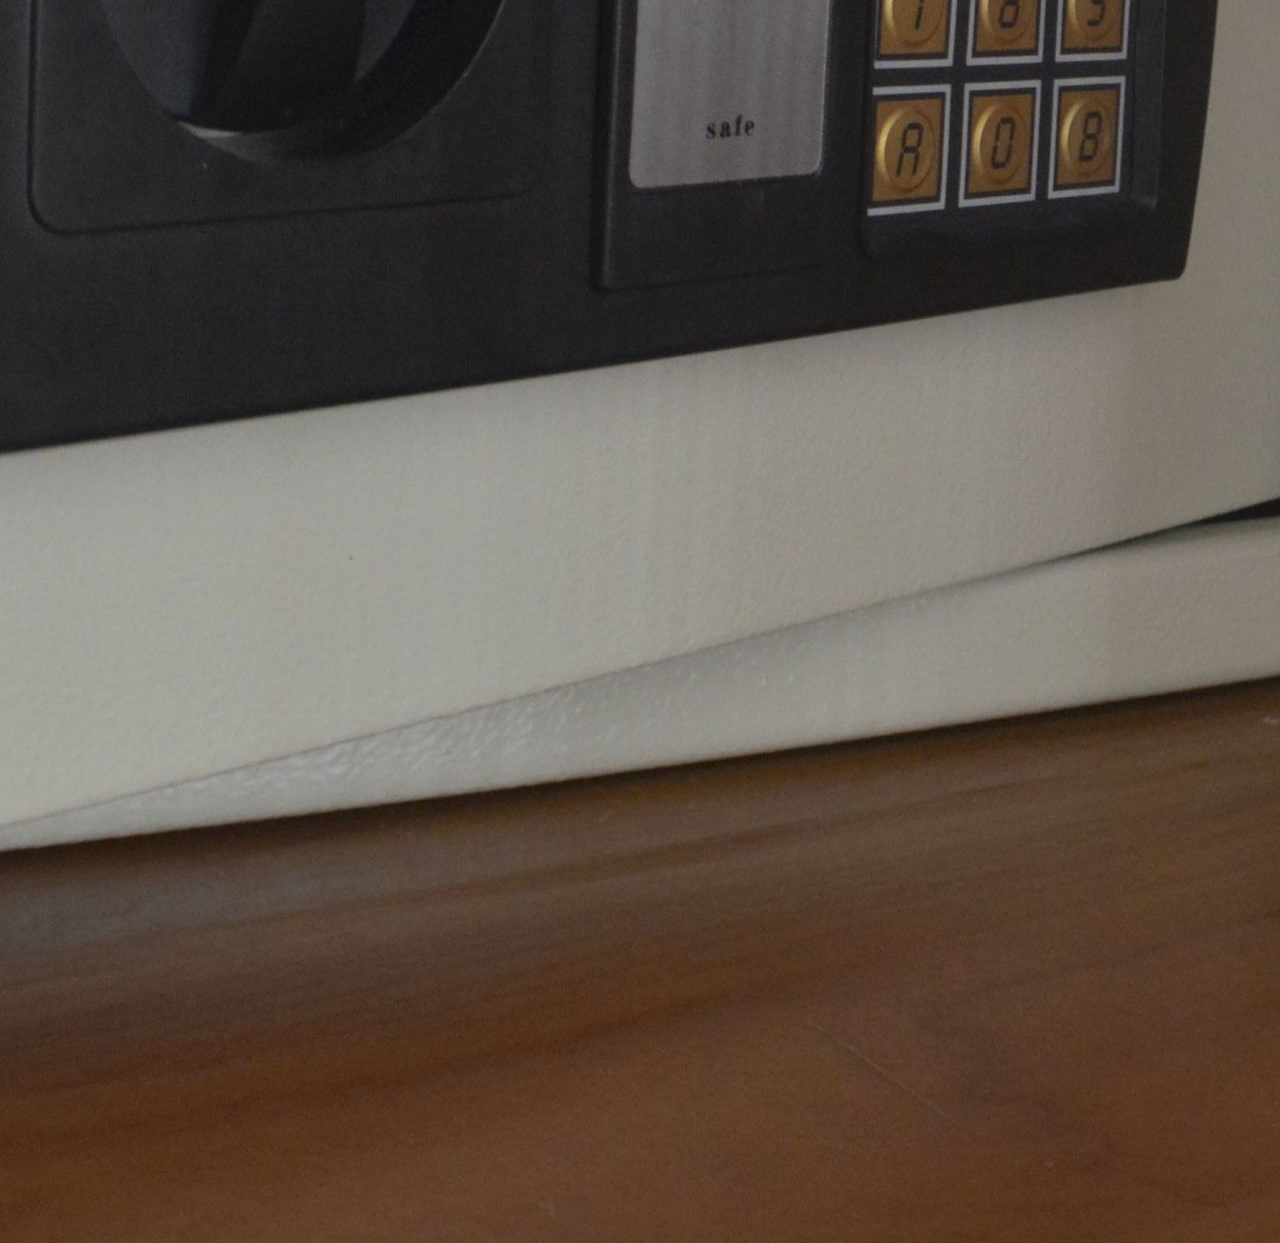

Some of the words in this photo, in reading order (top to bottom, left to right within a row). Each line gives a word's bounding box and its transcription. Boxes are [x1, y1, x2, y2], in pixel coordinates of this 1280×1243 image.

[705, 114, 756, 140] safe
[896, 122, 924, 178] A
[991, 117, 1017, 170] 0
